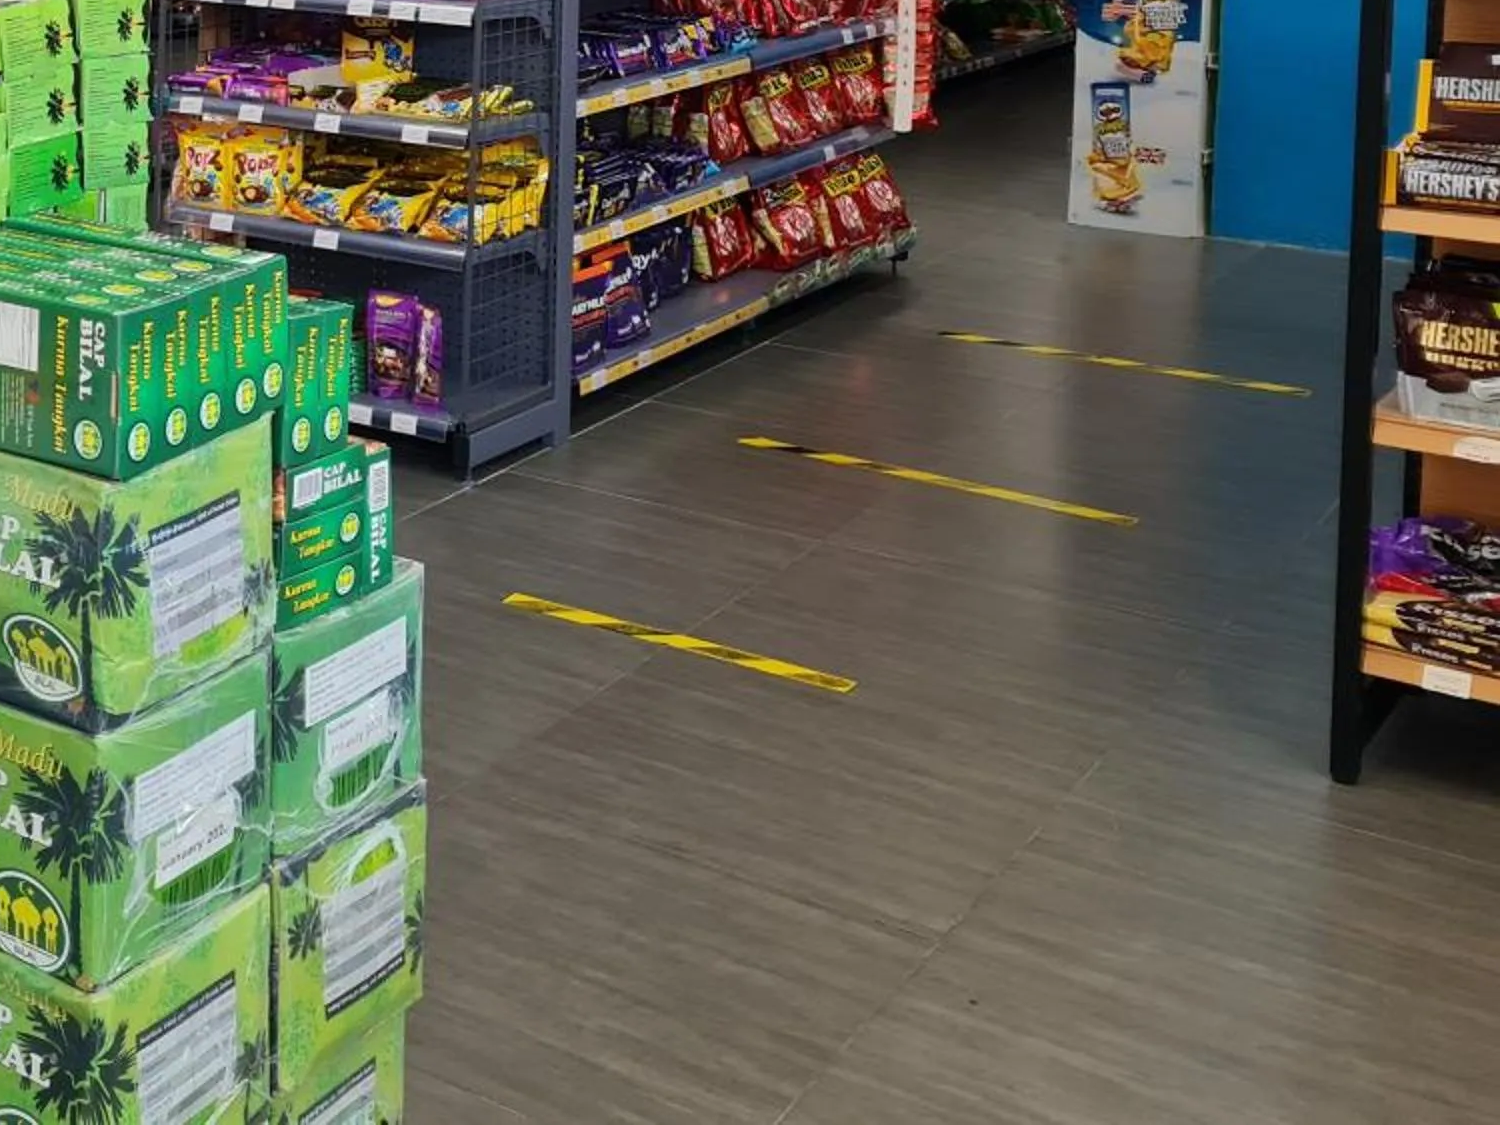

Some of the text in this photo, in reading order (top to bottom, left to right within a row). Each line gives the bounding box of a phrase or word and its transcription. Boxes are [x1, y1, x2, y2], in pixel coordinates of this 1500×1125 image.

[1405, 169, 1500, 202] HERSHEY'S
[79, 318, 93, 401] BILAL
[93, 321, 106, 368] CAP
[52, 315, 69, 455] Kurma Tangkai
[323, 469, 363, 494] BILAL
[324, 462, 347, 478] CAP
[7, 473, 75, 522] Madu
[291, 526, 321, 544] Kurma
[284, 579, 317, 598] Kurma
